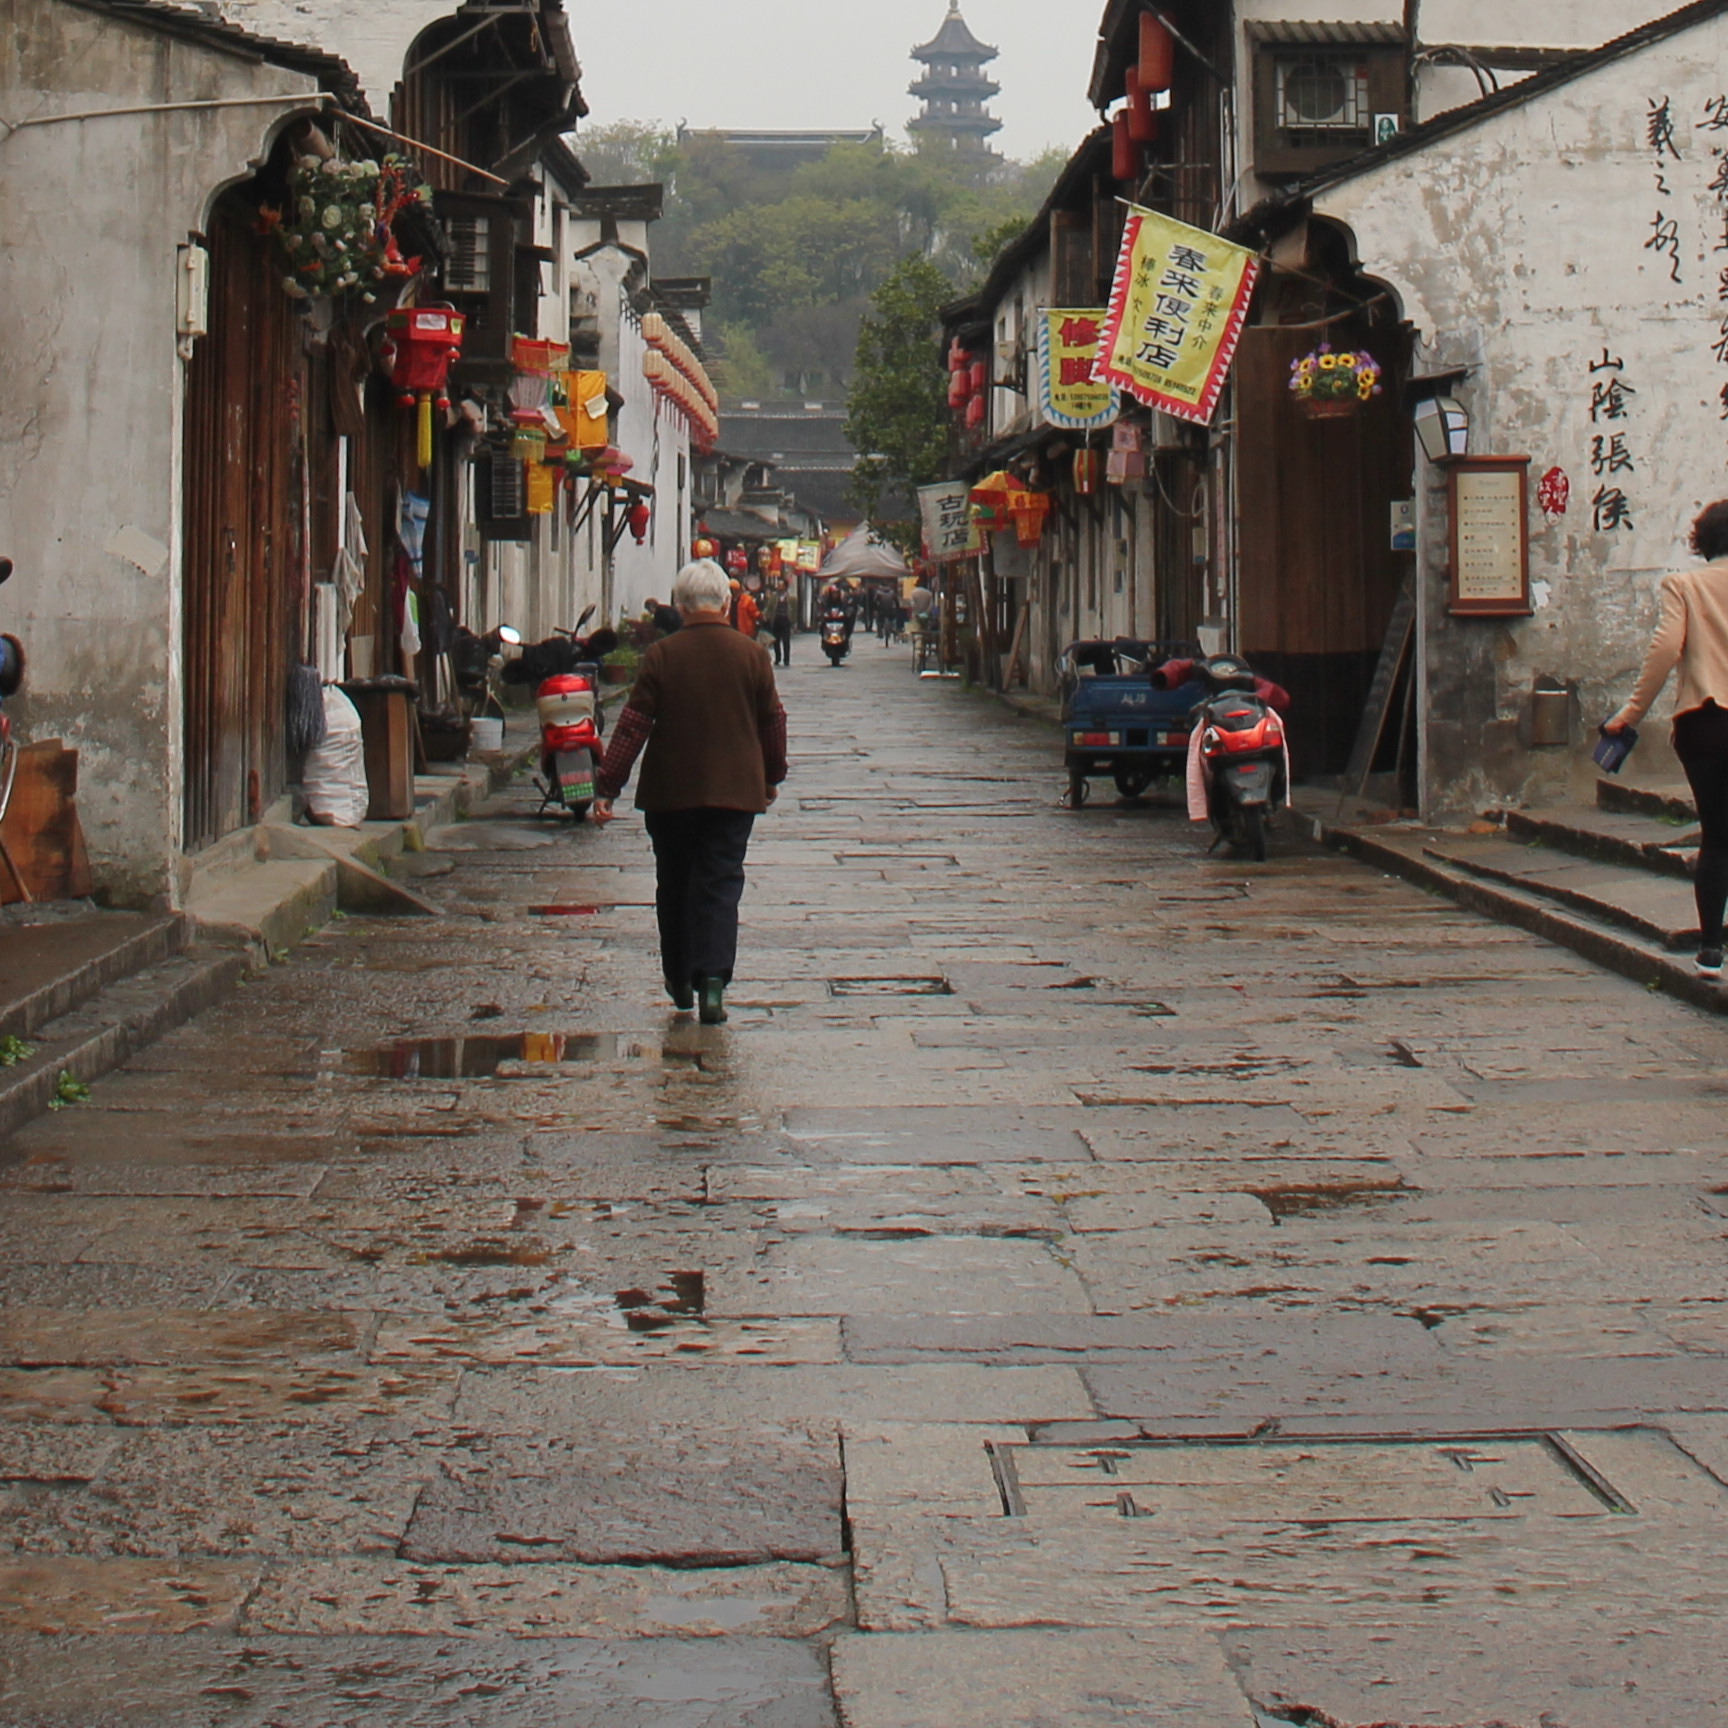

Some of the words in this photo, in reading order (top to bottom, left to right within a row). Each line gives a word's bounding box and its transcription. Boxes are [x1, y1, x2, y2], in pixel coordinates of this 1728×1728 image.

[1135, 243, 1208, 371] 春来便利店
[1191, 284, 1225, 351] 春来中介
